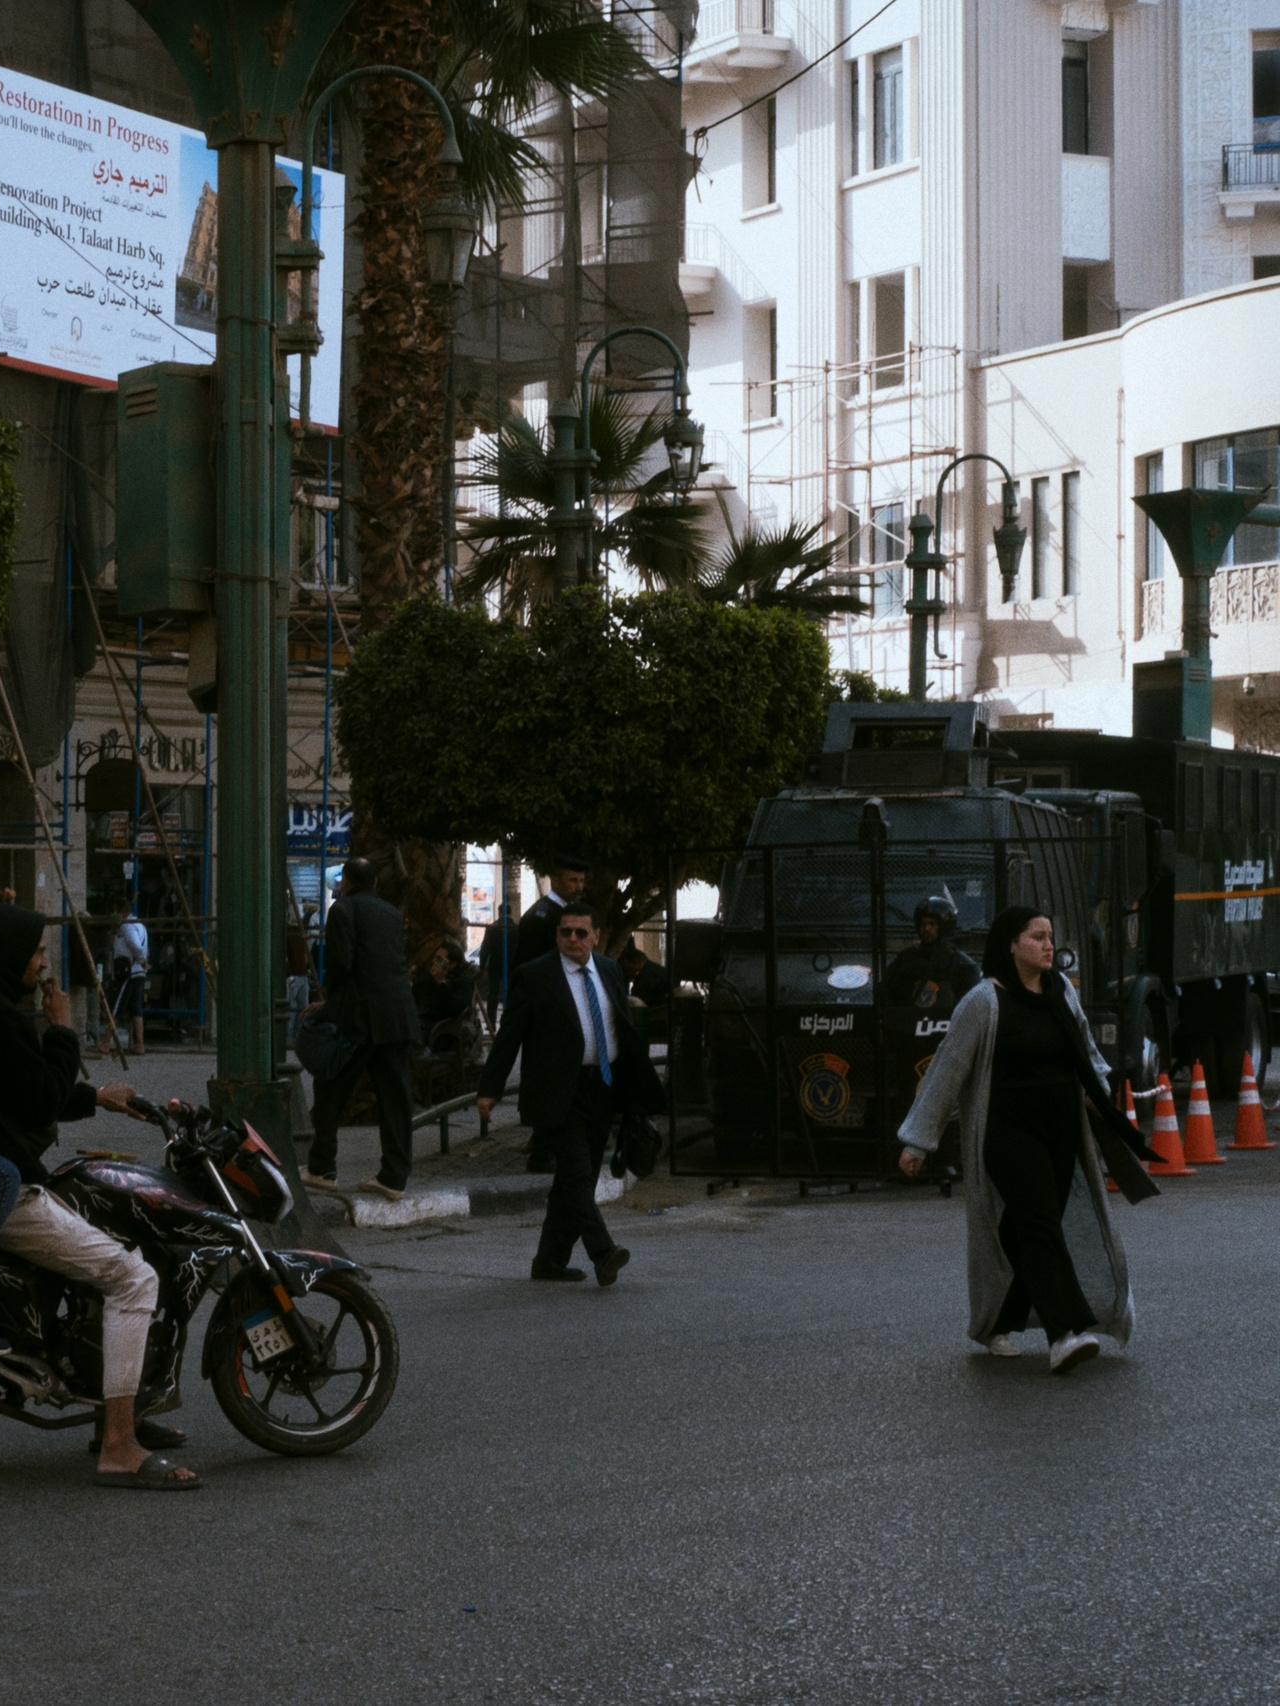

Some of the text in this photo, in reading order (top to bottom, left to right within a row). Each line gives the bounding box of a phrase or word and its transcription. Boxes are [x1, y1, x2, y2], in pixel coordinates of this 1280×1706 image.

[19, 118, 39, 136] love
[40, 126, 56, 141] the
[56, 131, 94, 153] changes.
[87, 110, 102, 134] in
[107, 116, 170, 155] Progress
[93, 159, 167, 197] الترميم جاري
[62, 195, 103, 224] Project
[79, 226, 113, 252] Talaat
[117, 236, 146, 260] Harb
[148, 245, 166, 270] Sq.
[37, 275, 61, 293] حرب
[65, 280, 96, 299] طلعت
[106, 266, 165, 291] مشروع ترميم
[99, 287, 126, 311] ميدان
[142, 298, 163, 316] عقار
[131, 327, 162, 344] Consultant
